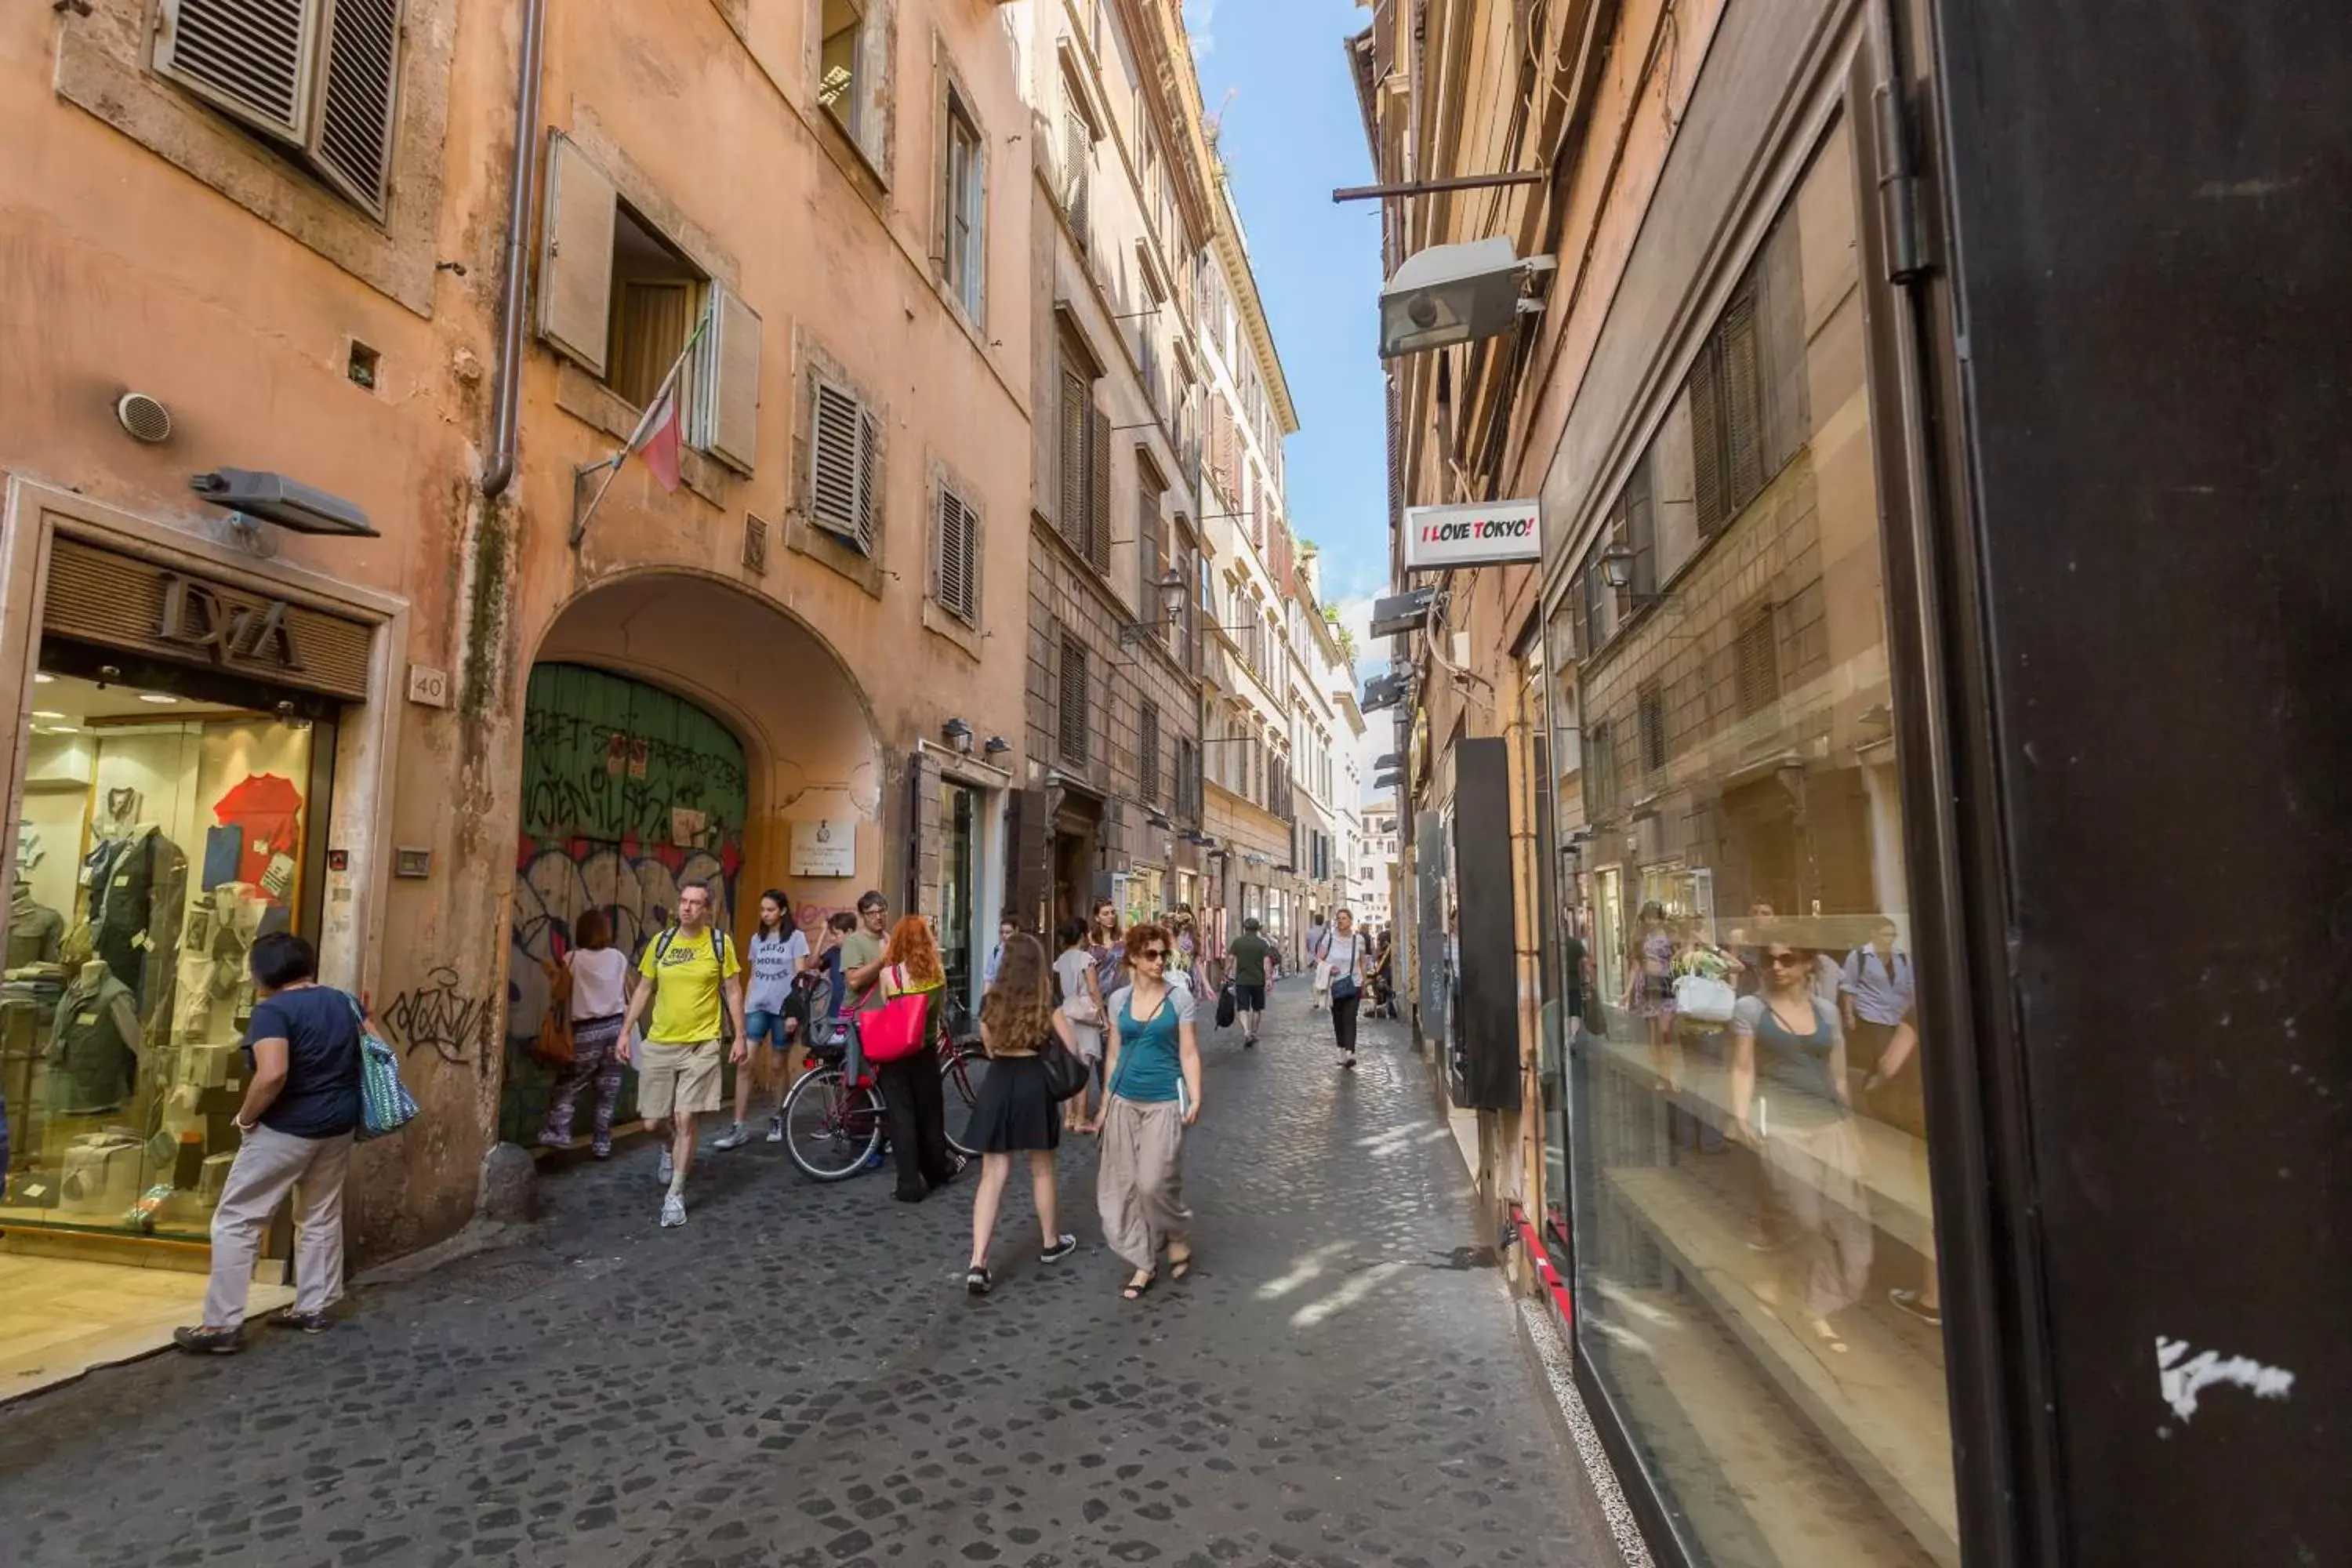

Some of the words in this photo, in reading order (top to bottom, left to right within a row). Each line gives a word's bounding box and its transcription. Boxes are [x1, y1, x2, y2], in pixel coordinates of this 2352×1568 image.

[1421, 526, 1429, 543] I
[1431, 522, 1472, 542] LOVE
[1474, 517, 1536, 539] TOKYO!
[416, 677, 441, 697] 40
